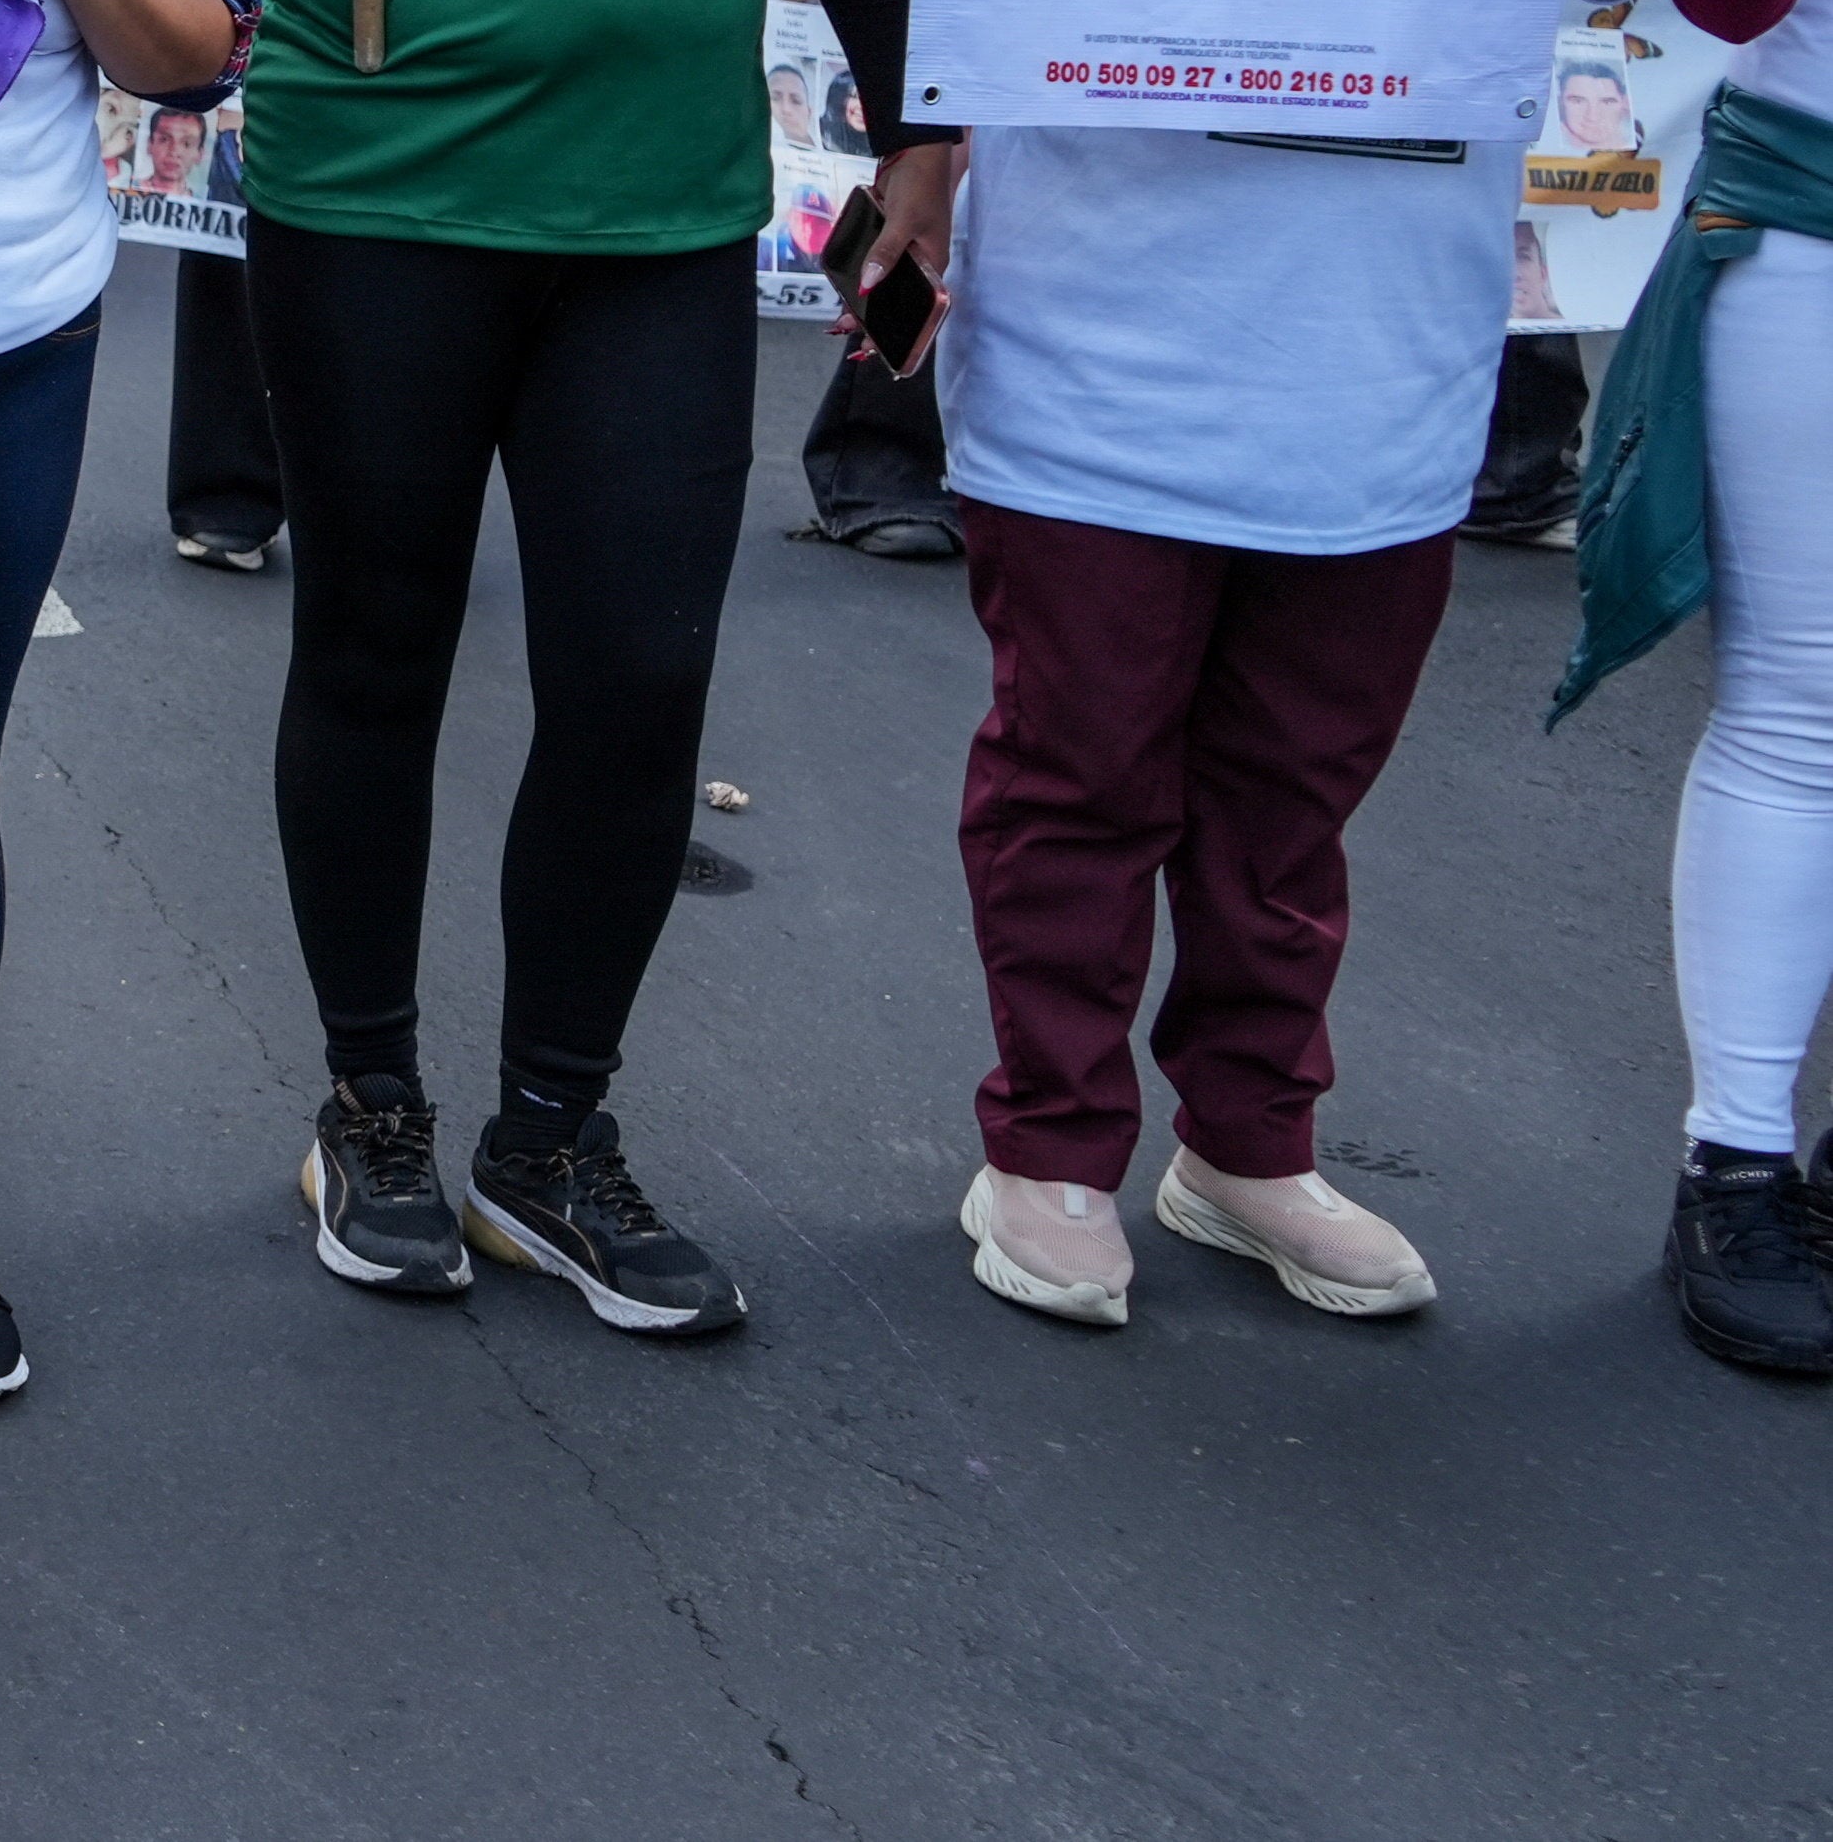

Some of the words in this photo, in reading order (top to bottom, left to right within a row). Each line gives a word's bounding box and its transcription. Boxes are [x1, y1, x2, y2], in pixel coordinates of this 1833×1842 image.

[1046, 61, 1090, 84] 800
[1098, 63, 1138, 85] 509
[1146, 64, 1175, 87] 09
[1184, 66, 1215, 88] 27
[1240, 69, 1282, 90] 800
[1290, 71, 1333, 93] 216
[1342, 73, 1373, 95] 03
[1383, 74, 1409, 97] 61
